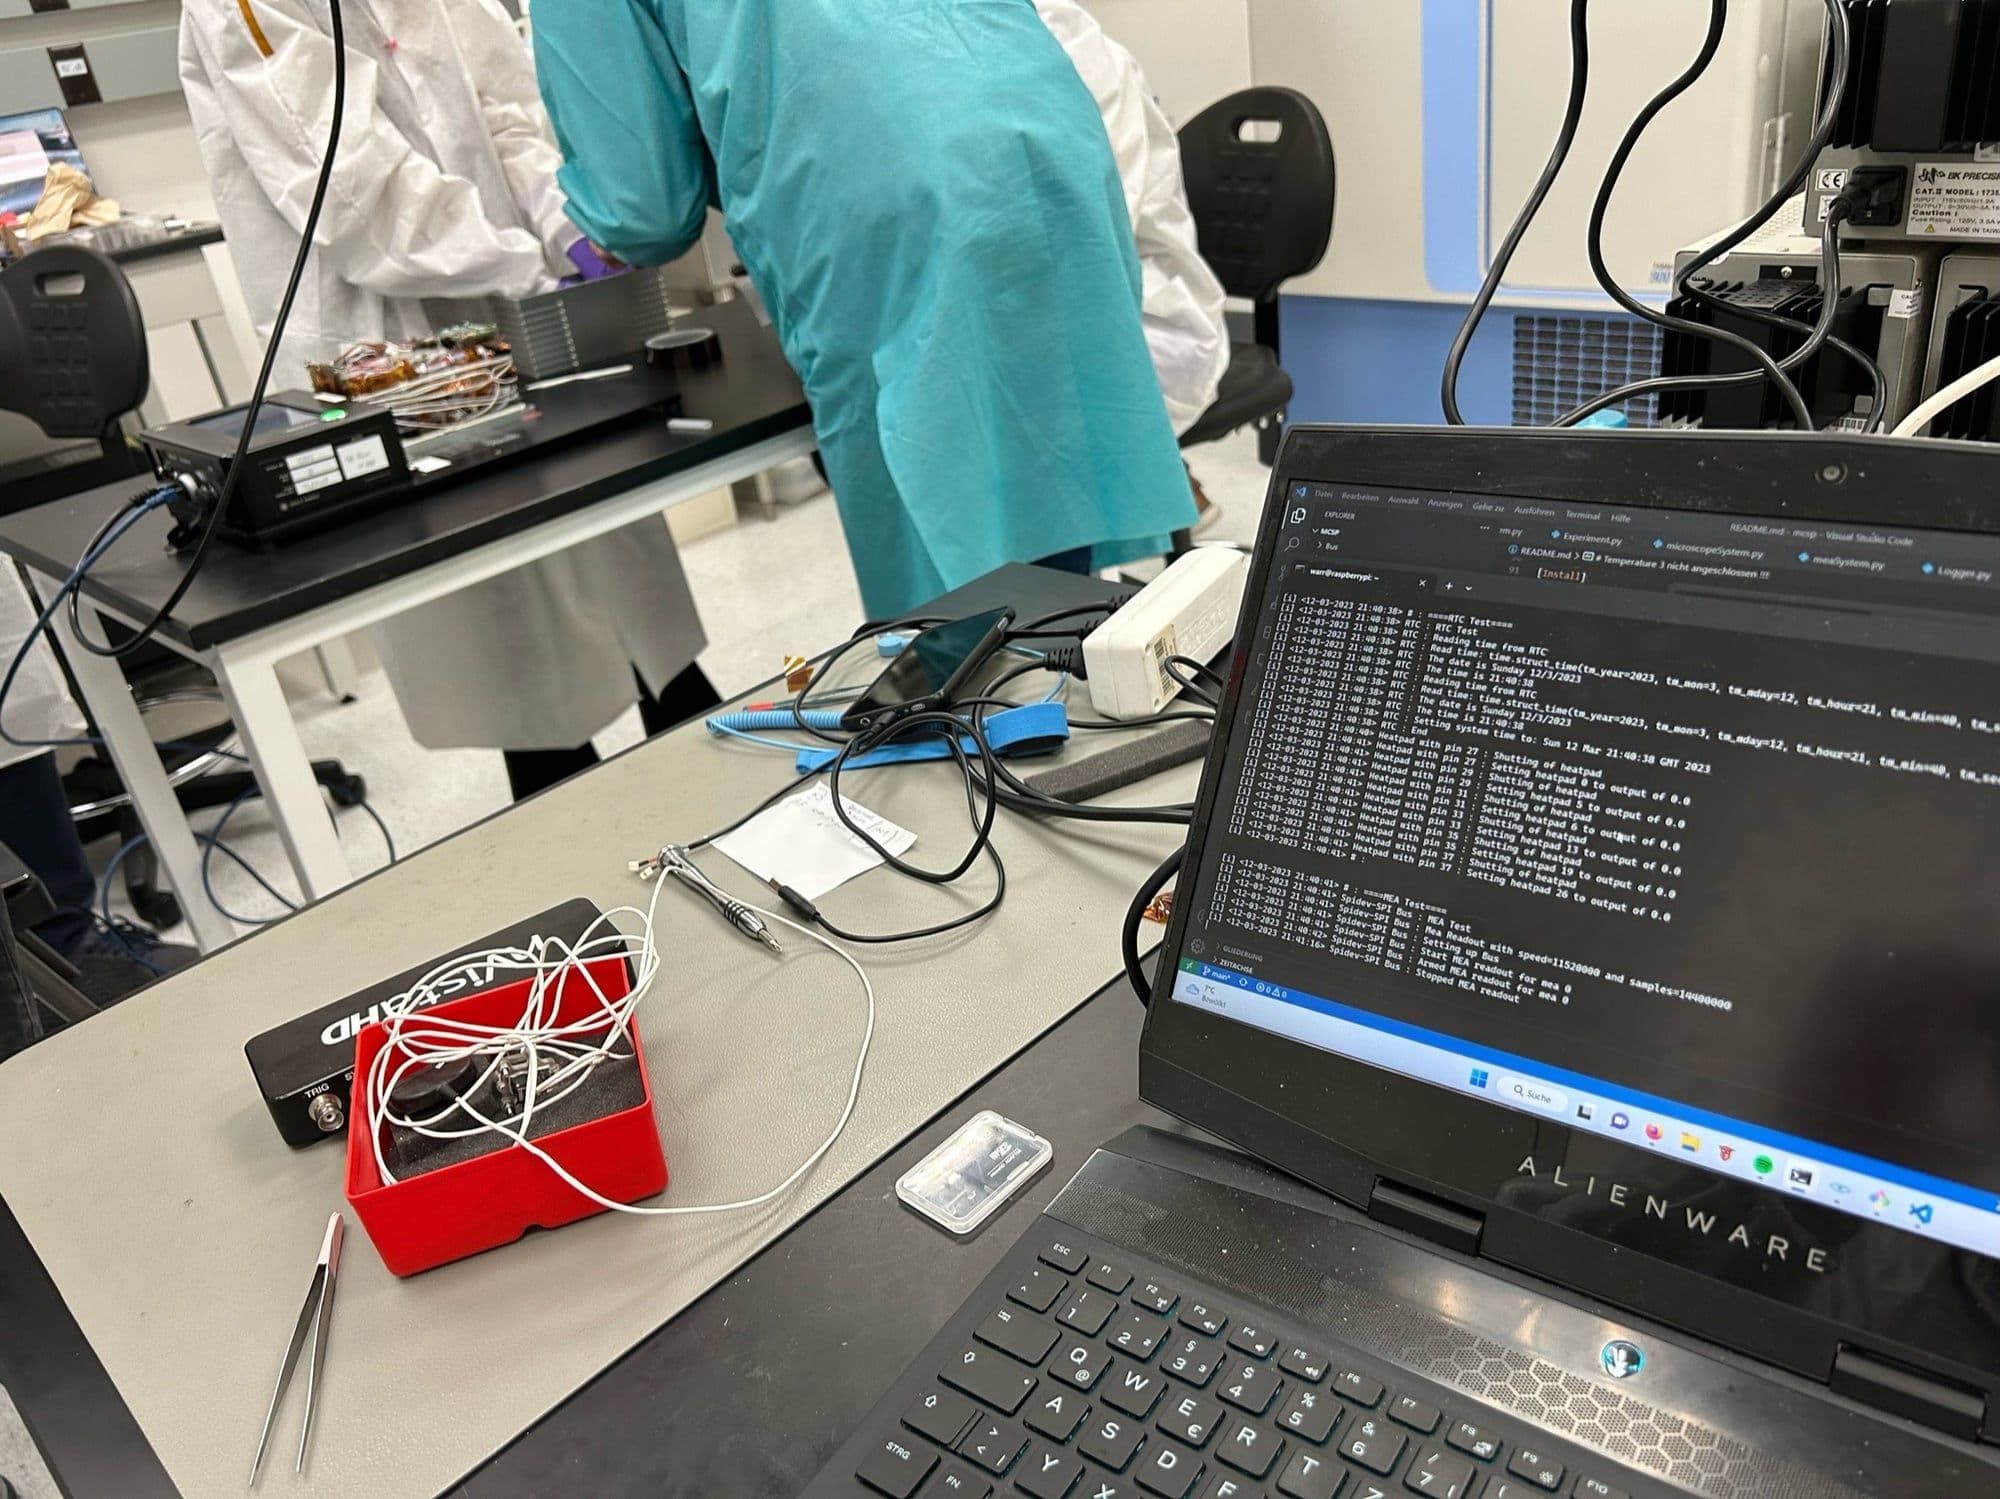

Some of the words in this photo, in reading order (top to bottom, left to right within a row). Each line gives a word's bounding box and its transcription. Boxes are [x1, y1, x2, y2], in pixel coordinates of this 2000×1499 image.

[1822, 172, 1842, 188] CE
[1948, 172, 1961, 180] BK
[1962, 172, 2000, 181] PRECISI
[1946, 188, 1974, 196] MODEL
[1315, 490, 1334, 499] Datei
[1342, 492, 1380, 502] Bearbeiten
[1388, 496, 1420, 505] Auswahl
[1428, 499, 1464, 510] Anzeigen
[1472, 502, 1492, 512] Gehe
[1494, 505, 1505, 513] zu
[1514, 506, 1556, 517] Ausführen
[1566, 510, 1601, 521] Terminal
[1611, 514, 1632, 524] Hilfe
[1324, 511, 1356, 520] EXPLORER
[1320, 528, 1340, 536] MCSP
[1730, 523, 1784, 537] README.md
[1792, 530, 1817, 540] mcsp
[1826, 532, 1854, 542] Visual
[1855, 533, 1886, 545] Studio
[1888, 536, 1914, 546] Code
[1326, 542, 1338, 551] Bus
[1521, 546, 1572, 560] README.md
[1604, 555, 1656, 569] Temperature
[1658, 560, 1665, 569] 3
[1667, 561, 1690, 573] nicht
[1692, 564, 1758, 579] angeschlossen
[1760, 570, 1770, 579] !!!
[1563, 532, 1623, 546] Experiment.py
[1666, 541, 1764, 560] microscopeSystem.py
[1813, 554, 1886, 571] meaSystem.py
[1938, 566, 1992, 582] Logger.py
[1508, 566, 1520, 574] 91
[1537, 568, 1586, 584] [Install]
[1283, 593, 1298, 603] [i]
[1301, 596, 1355, 609] <12-03-2023
[1358, 603, 1403, 615] 21:40:38>
[1276, 622, 1292, 632] [i]
[1295, 625, 1348, 639] <12-03-2023
[1351, 632, 1396, 645] 21:40:38>
[1400, 639, 1417, 649] RTC
[1430, 643, 1452, 654] Read
[1456, 647, 1482, 658] time:
[1488, 651, 1659, 685] time.struct_time(tm_year=2023,
[1665, 676, 1722, 693] tm_mon=3,
[1231, 815, 1246, 827] [i]
[1249, 820, 1301, 838] <12-03-2023
[1304, 831, 1349, 848] 21:40:41>
[1353, 842, 1389, 858] Heatpad
[1393, 852, 1415, 864] with
[1418, 858, 1435, 868] pin
[1439, 862, 1452, 872] 37
[1466, 868, 1505, 886] Setting
[1510, 877, 1551, 894] heatpad
[1555, 887, 1568, 898] 26
[1573, 891, 1586, 902] to
[1590, 898, 1628, 912] output
[1632, 906, 1646, 916] of
[1651, 909, 1671, 921] 0.0
[1217, 873, 1232, 885] [i]
[1235, 879, 1287, 898] <12-03-2023
[1290, 892, 1335, 909] 21:40:41>
[1338, 904, 1390, 924] Spidev-SPI
[1394, 917, 1410, 929] Bus
[1425, 925, 1442, 937] Mea
[1446, 930, 1486, 948] Readout
[1489, 943, 1513, 955] with
[1605, 972, 1625, 983] and
[1223, 945, 1264, 962] GLIEDERUNG
[1220, 958, 1254, 974] ZEITACHSE
[304, 1084, 331, 1098] TRIG
[1526, 1088, 1552, 1106] Suche
[1517, 1154, 1828, 1274] ALIENWARE
[1052, 1243, 1071, 1256] ESC
[1101, 1264, 1112, 1274] F1
[1146, 1284, 1158, 1295] F2
[1067, 1308, 1076, 1320] 1
[1193, 1304, 1206, 1316] F3
[1118, 1332, 1132, 1345] 2
[1242, 1326, 1256, 1338] F4
[1185, 1340, 1197, 1352] §
[1293, 1348, 1308, 1360] F5
[1070, 1348, 1088, 1365] Q
[1172, 1357, 1186, 1370] 3
[1074, 1369, 1090, 1382] @
[1124, 1370, 1150, 1392] W
[1242, 1366, 1254, 1380] $
[1346, 1372, 1361, 1385] F6
[1228, 1384, 1243, 1398] 4
[1045, 1396, 1063, 1414] A
[1178, 1398, 1197, 1416] E
[1301, 1392, 1316, 1408] %
[1402, 1397, 1416, 1408] F7
[1288, 1412, 1304, 1426] 5
[1101, 1422, 1120, 1440] S
[1187, 1424, 1203, 1438] €
[1236, 1426, 1258, 1446] R
[1361, 1420, 1376, 1436] &
[1461, 1423, 1476, 1436] F8
[886, 1440, 912, 1461] STRG
[1352, 1440, 1366, 1456] 6
[1041, 1453, 1060, 1472] Y
[1156, 1450, 1177, 1470] D
[1522, 1450, 1538, 1464] F9
[1302, 1456, 1320, 1476] T
[945, 1474, 961, 1489] FN
[1420, 1470, 1434, 1487] 7
[1586, 1479, 1608, 1494] F10
[1217, 1480, 1238, 1498] F
